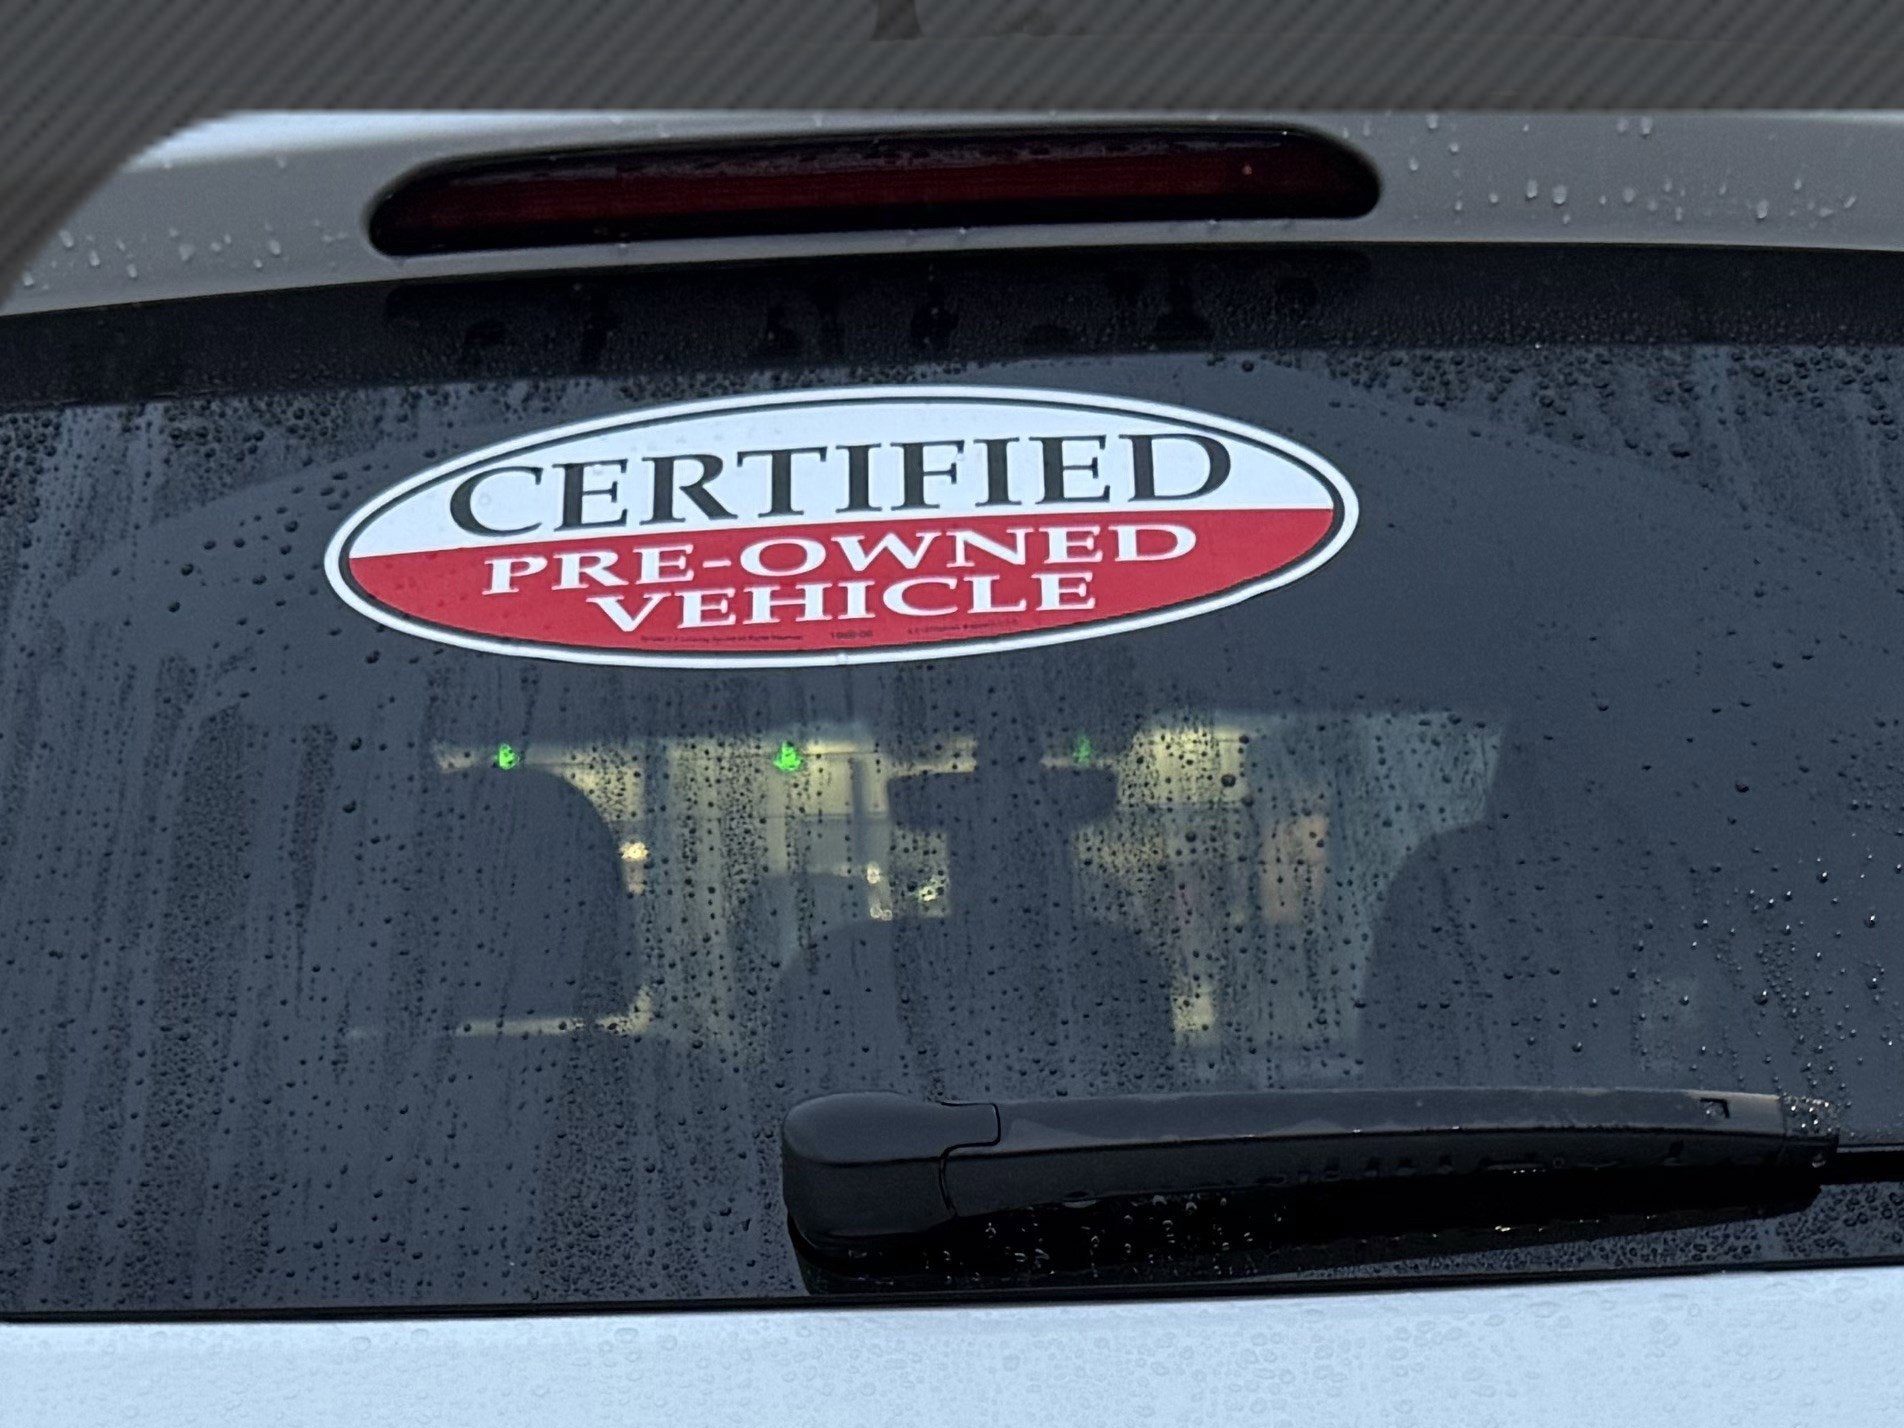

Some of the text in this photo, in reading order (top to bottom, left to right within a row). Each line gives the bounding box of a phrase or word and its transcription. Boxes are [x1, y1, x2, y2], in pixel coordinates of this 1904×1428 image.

[449, 432, 1232, 537] CERTIFIED
[482, 523, 1197, 596] PRE-OWNED
[586, 571, 1096, 633] VEHICLE
